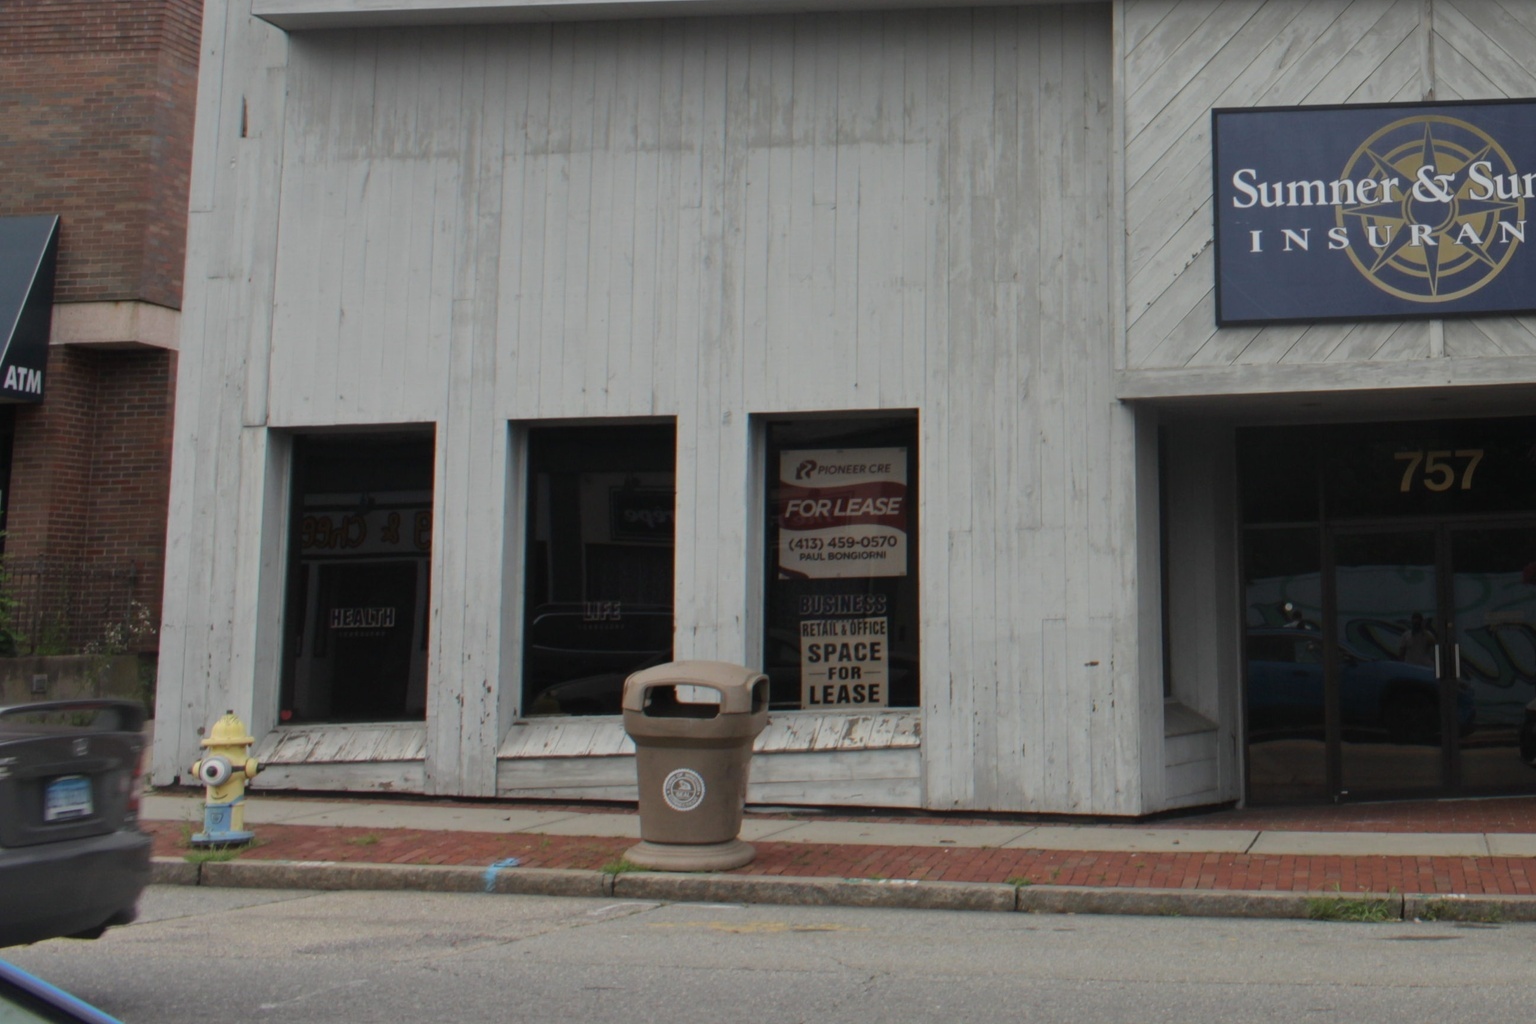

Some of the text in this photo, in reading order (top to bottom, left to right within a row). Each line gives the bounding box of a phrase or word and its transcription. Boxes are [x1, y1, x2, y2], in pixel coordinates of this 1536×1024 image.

[1232, 168, 1399, 208] Sumner
[1412, 164, 1456, 204] &
[3, 365, 42, 395] ATM
[818, 463, 891, 475] PIONEER CRE
[1394, 449, 1485, 492] 757
[785, 497, 902, 518] FOR LEASE
[788, 536, 898, 552] (413) 459-0570
[799, 551, 887, 562] PAUL BONGIORNI
[583, 600, 622, 621] LIFE
[800, 594, 887, 615] BUSINESS
[330, 607, 396, 629] HEALTH
[802, 622, 838, 637] RETAIL
[841, 624, 847, 636] &
[850, 620, 886, 636] OFFICE
[808, 642, 882, 663] SPACE
[828, 666, 861, 680] FOR
[809, 684, 880, 705] LEASE
